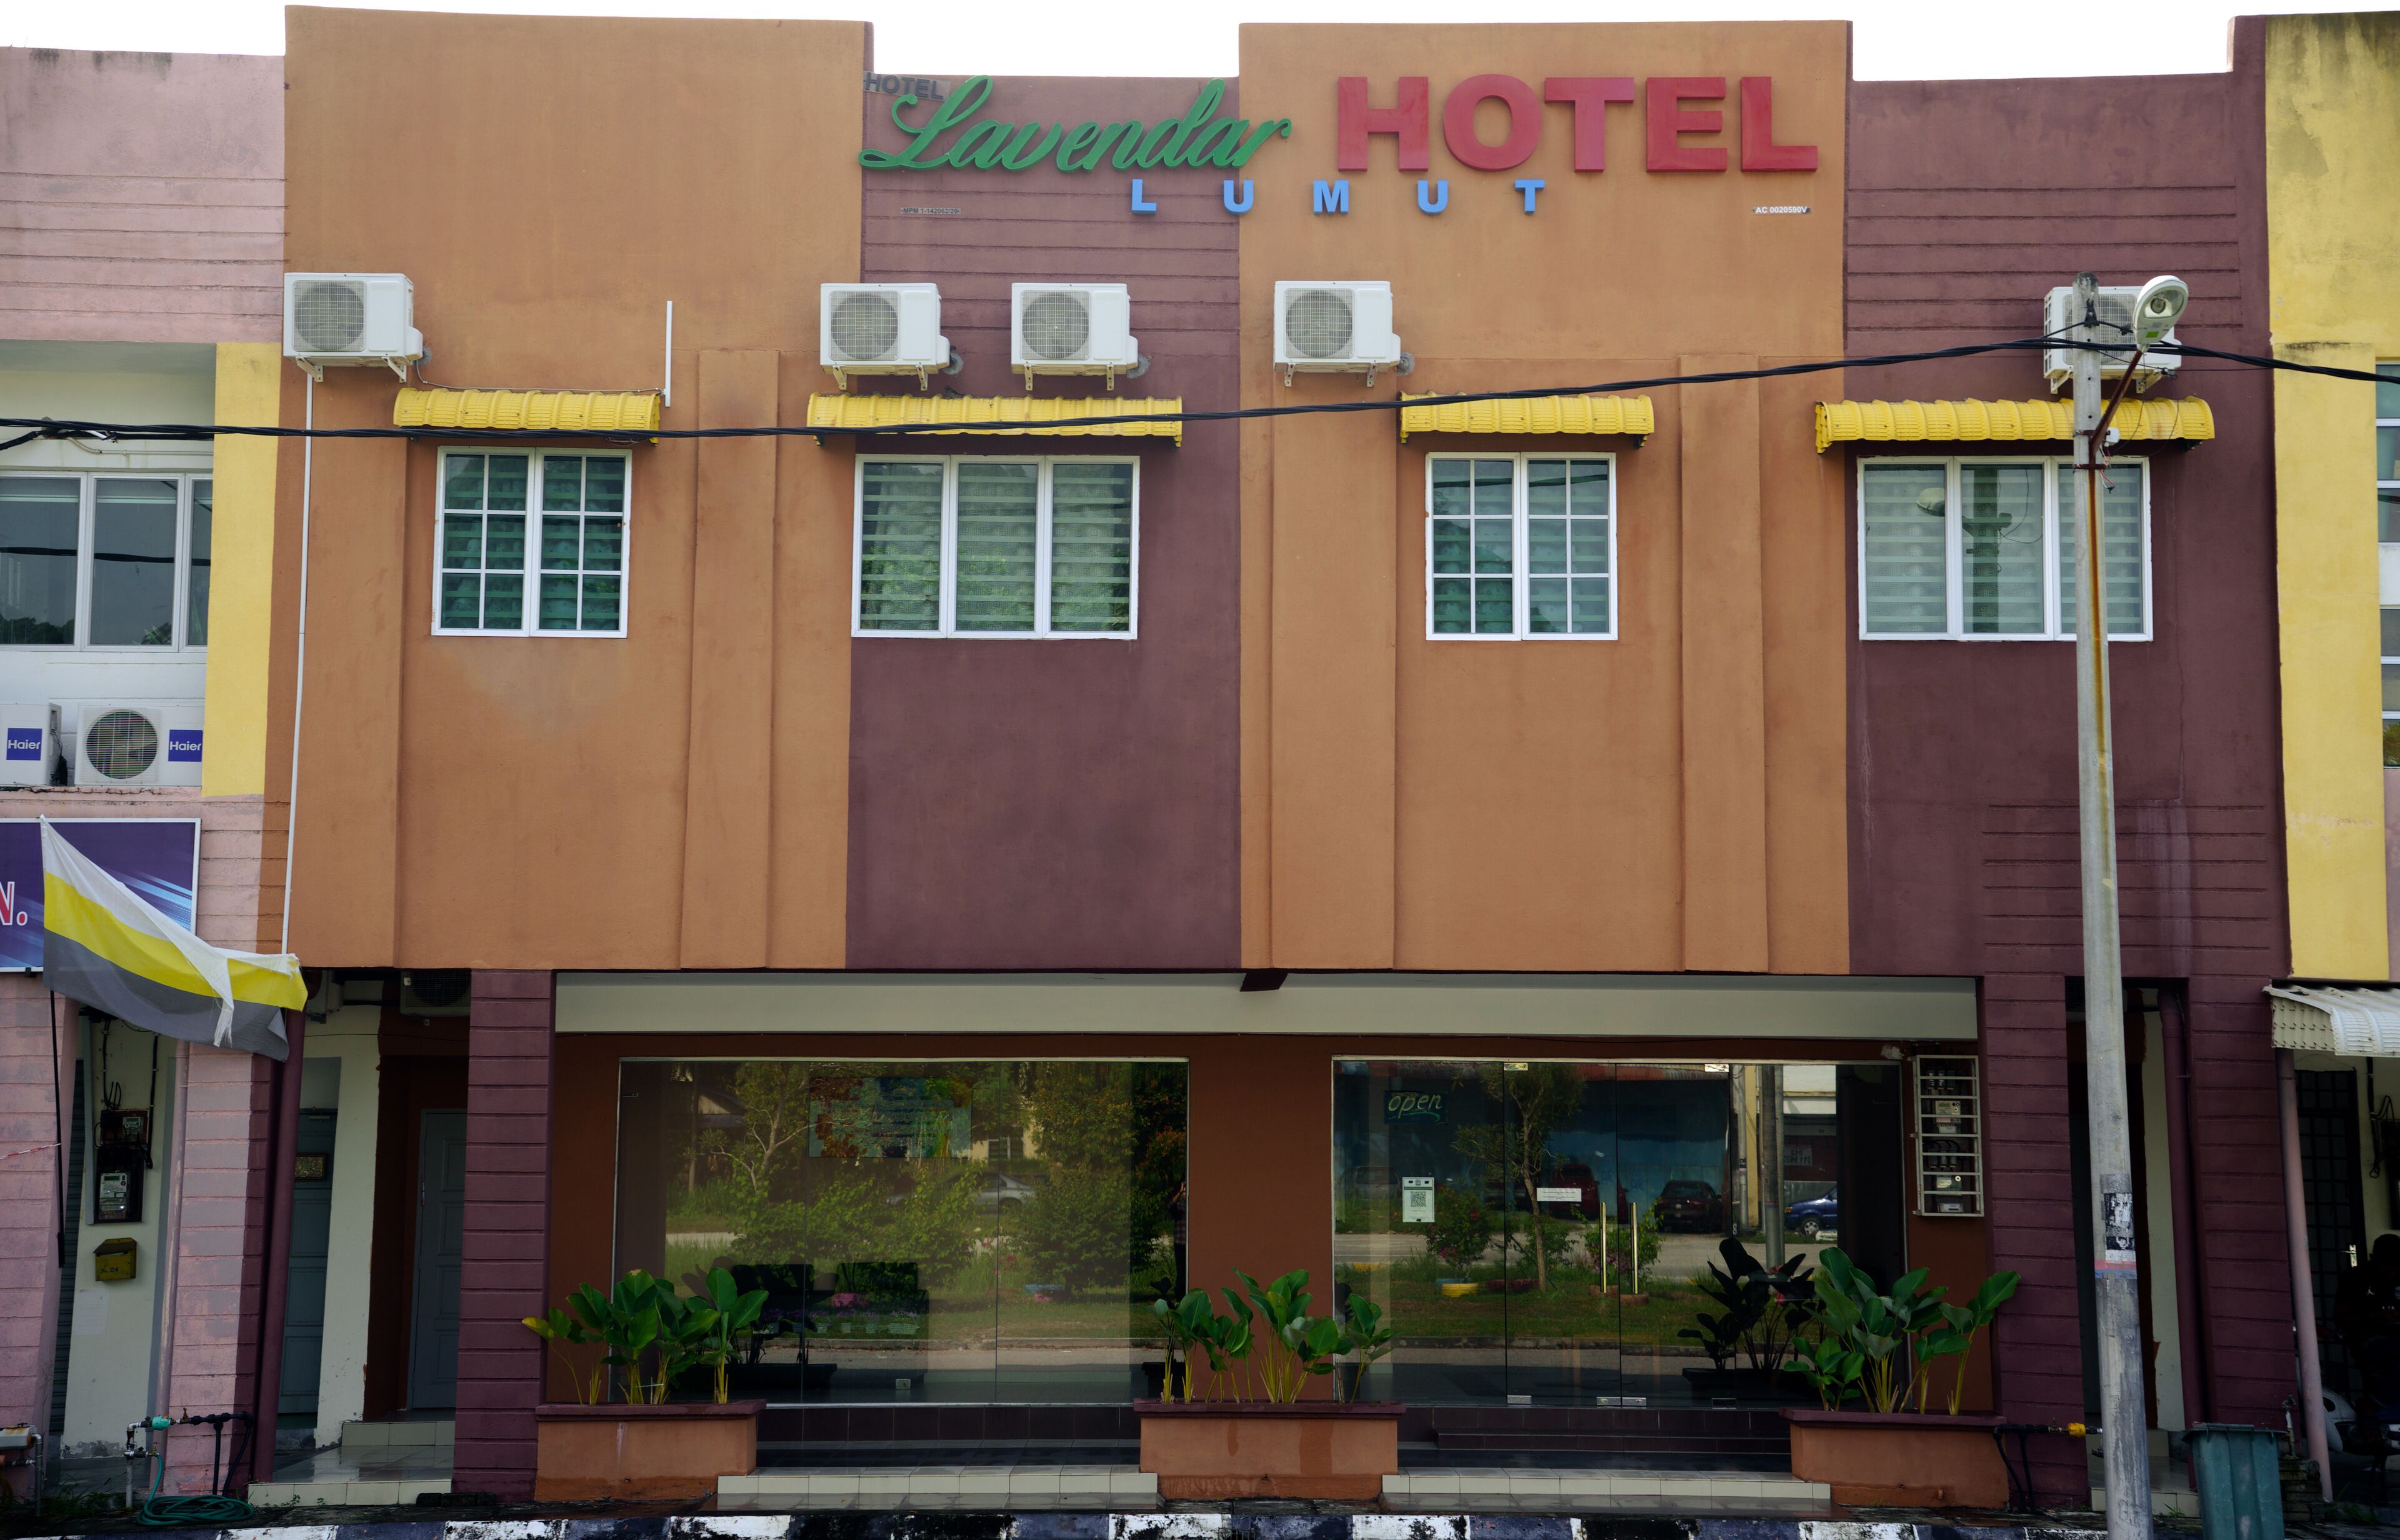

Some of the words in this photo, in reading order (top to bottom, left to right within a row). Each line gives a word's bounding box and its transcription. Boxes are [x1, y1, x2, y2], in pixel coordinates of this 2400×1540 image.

[864, 72, 944, 100] HOTEL
[859, 75, 1292, 172] Lavendar
[1338, 74, 1818, 172] HOTEL
[8, 739, 41, 750] Haier
[169, 741, 202, 751] Haier
[1388, 1094, 1442, 1119] open
